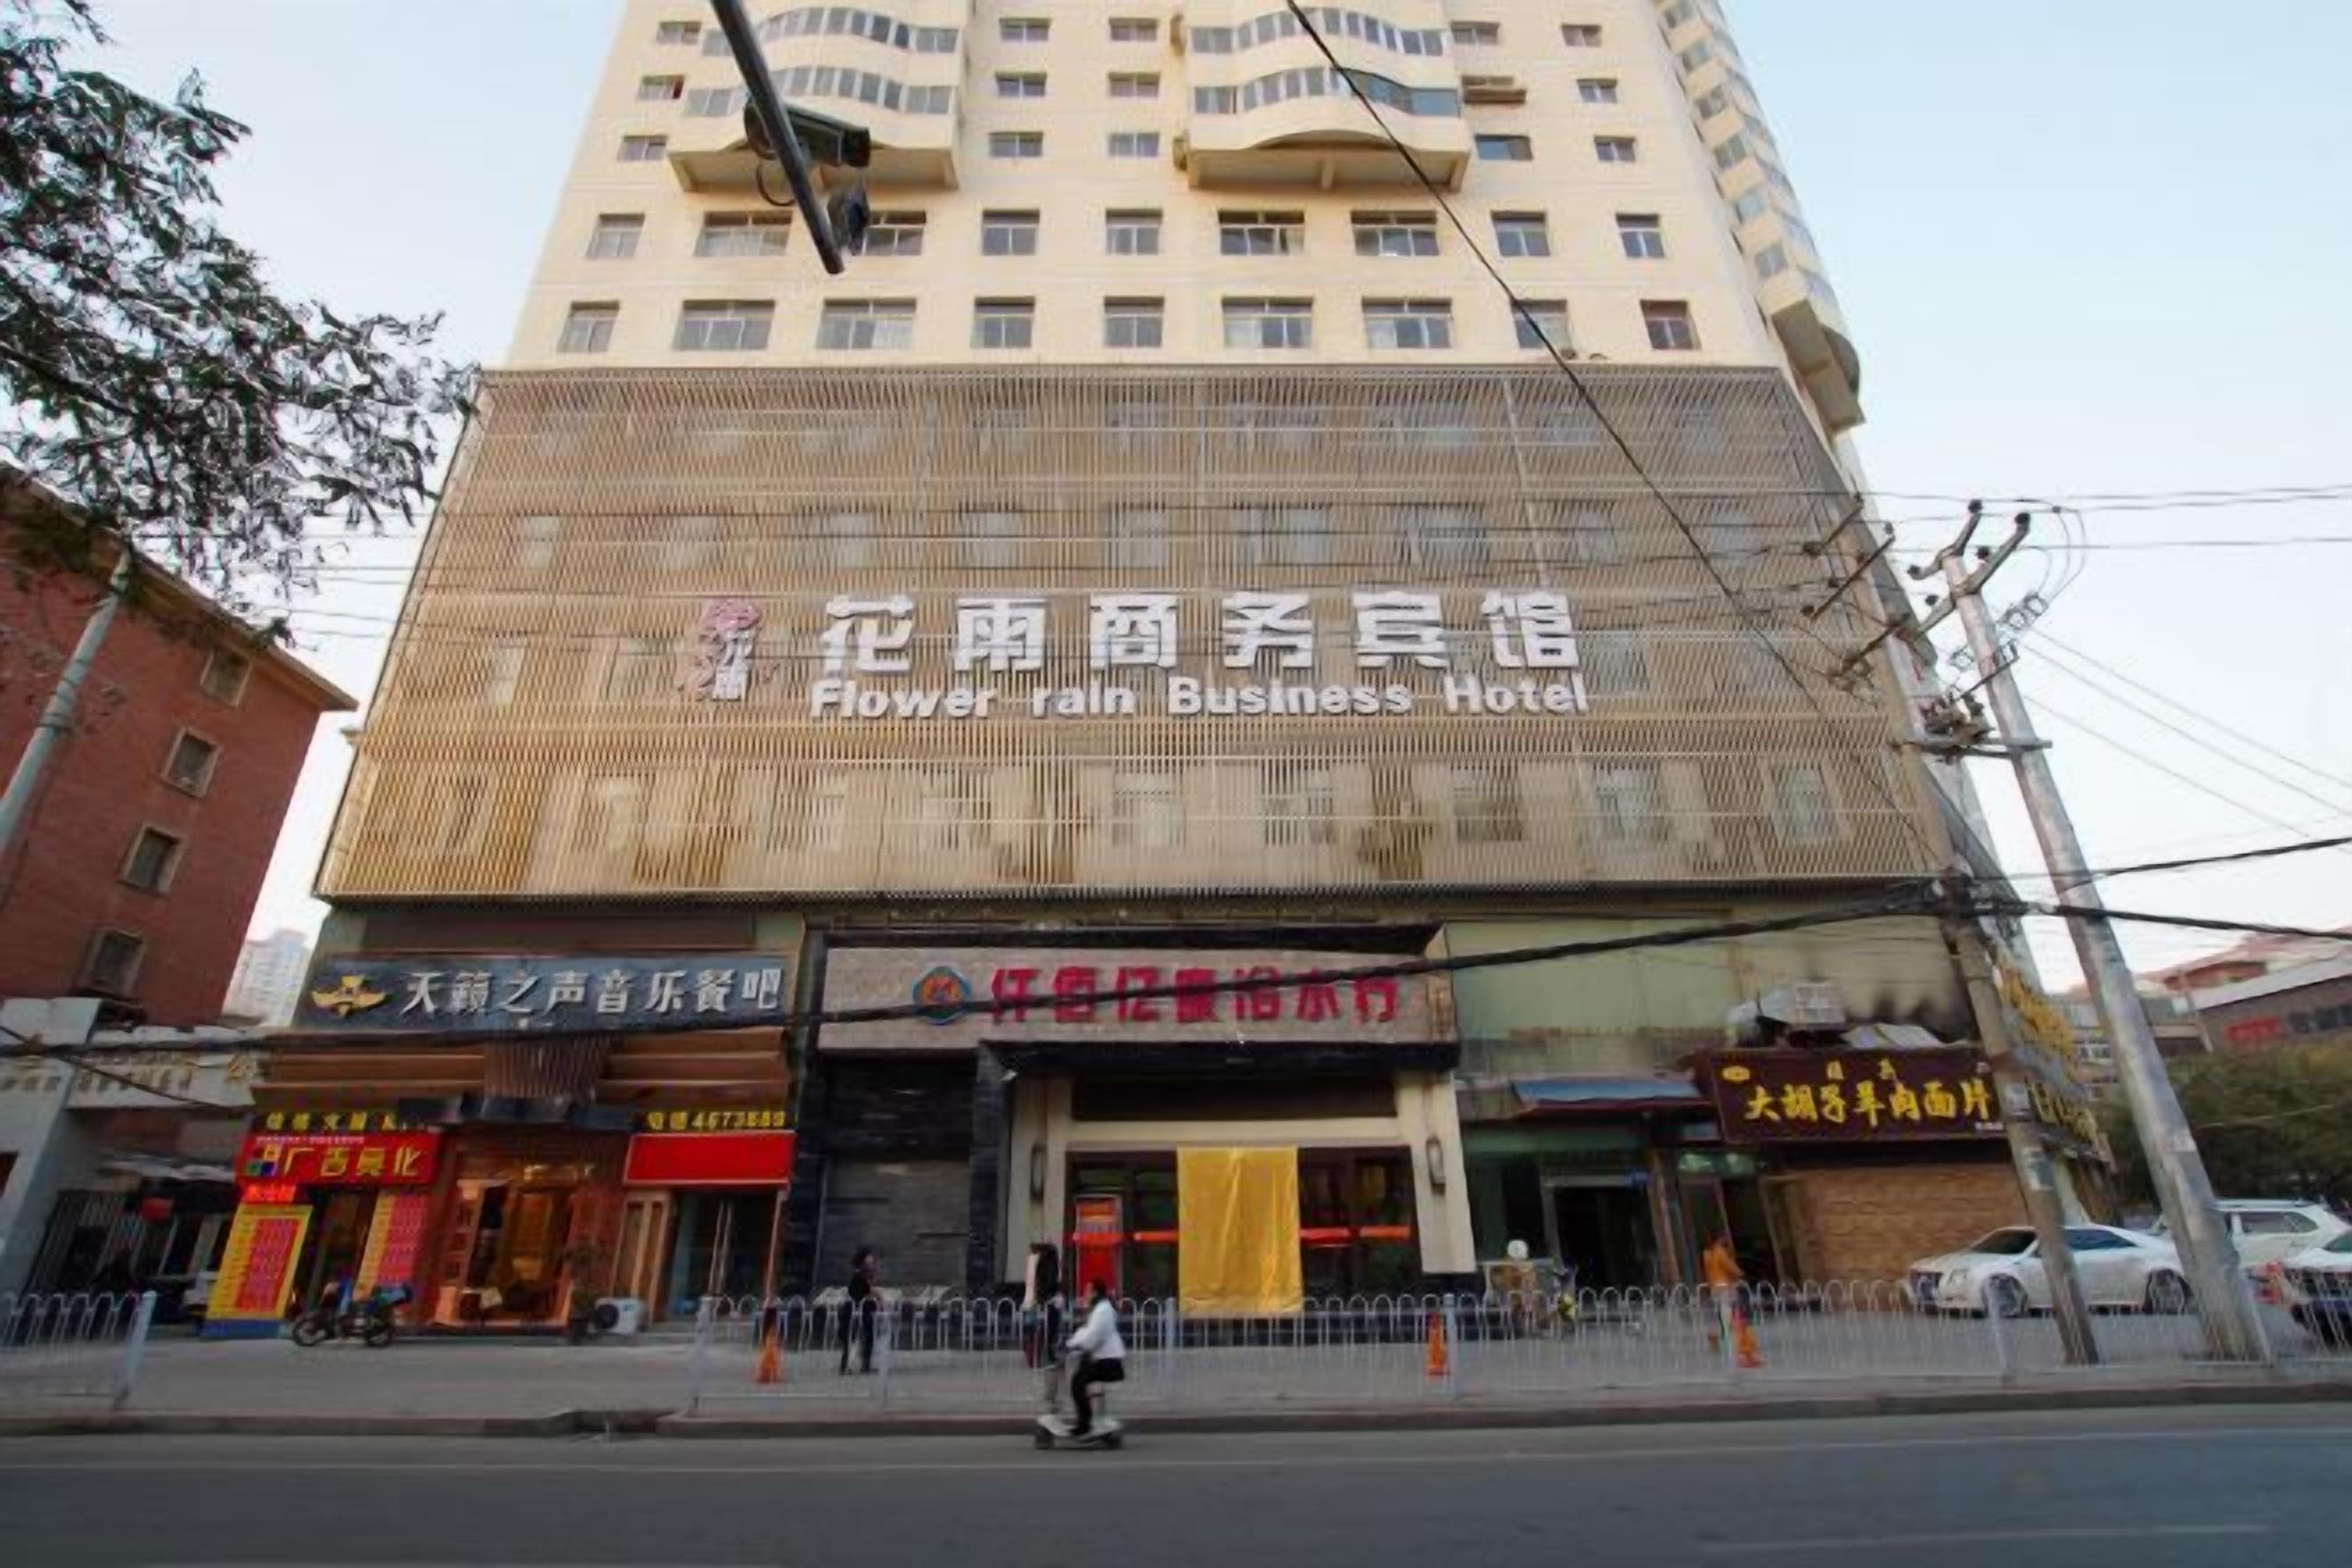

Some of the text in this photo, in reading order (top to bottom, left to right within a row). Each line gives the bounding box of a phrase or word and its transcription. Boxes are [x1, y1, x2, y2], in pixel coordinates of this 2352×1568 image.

[821, 589, 1580, 674] 花雨商务宾馆
[810, 674, 1589, 718] Flower rain Business Hotel
